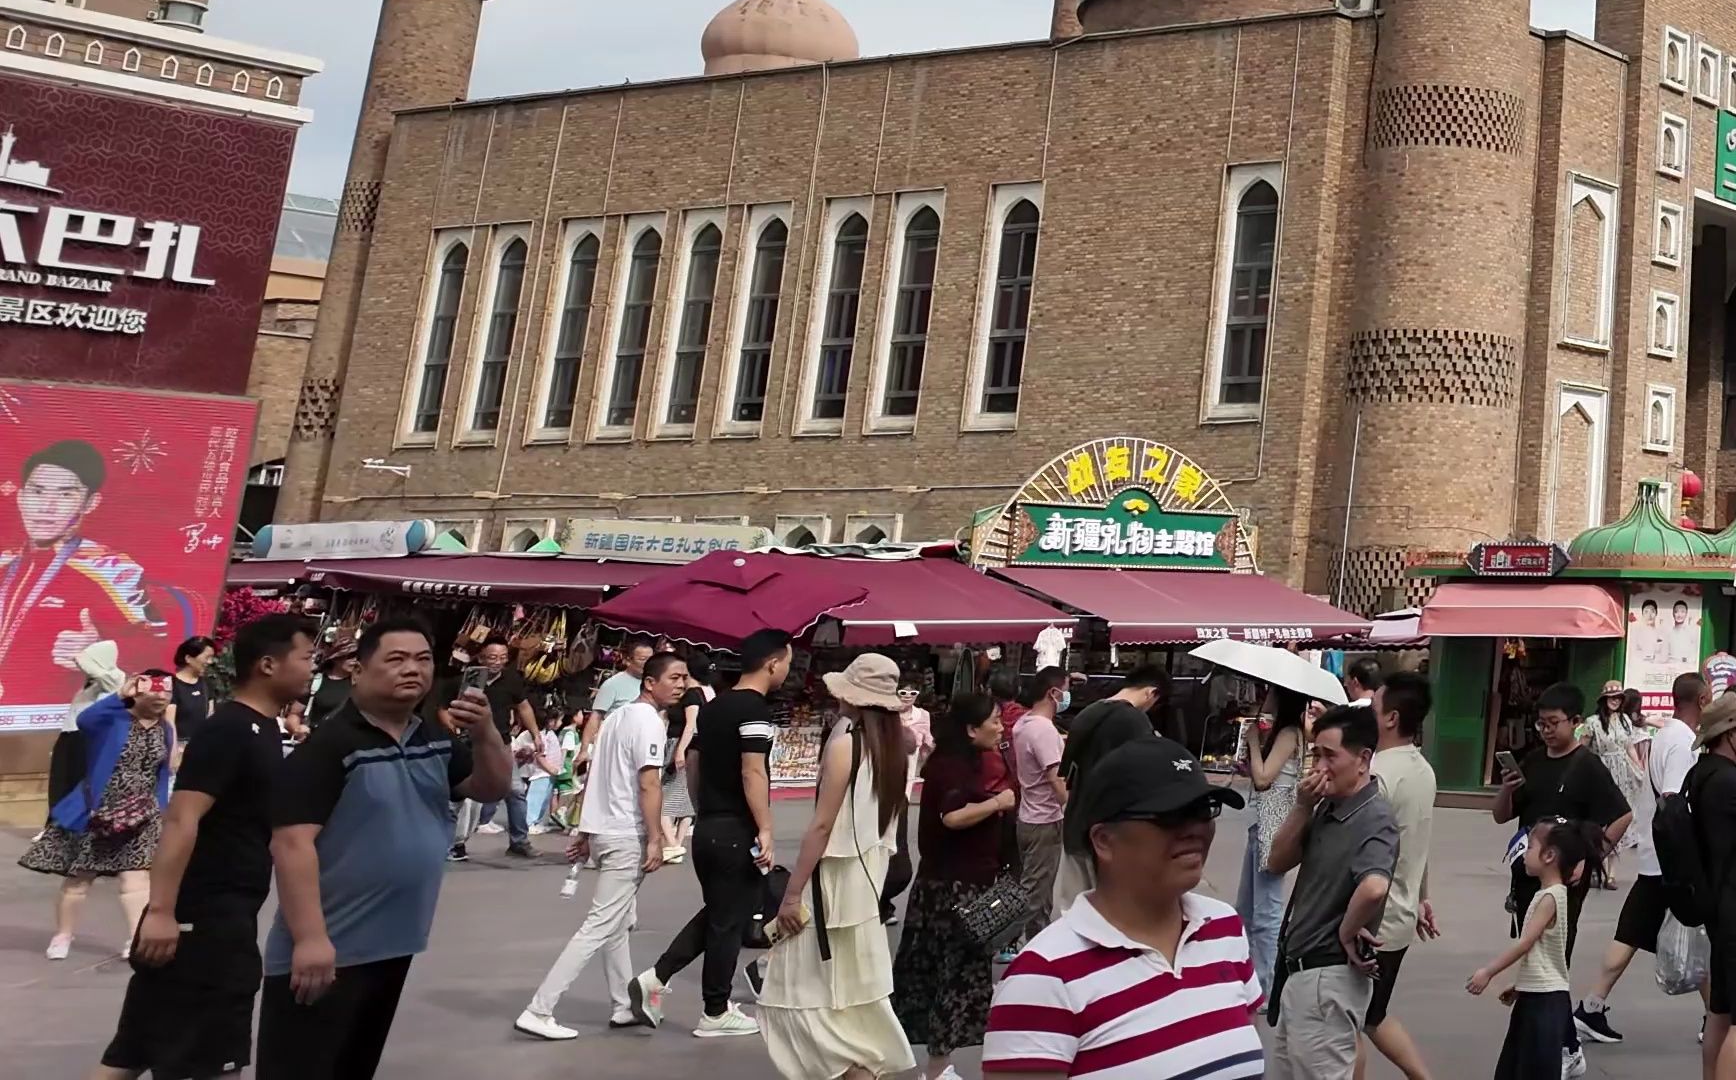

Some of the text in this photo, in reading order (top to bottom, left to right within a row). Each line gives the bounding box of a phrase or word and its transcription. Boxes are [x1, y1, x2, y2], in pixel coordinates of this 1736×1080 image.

[45, 273, 113, 293] BAZAAR
[0, 295, 148, 334] 景区欢迎您
[1066, 445, 1203, 504] 战友之家
[585, 532, 740, 555] 新疆国际大巴扎文创店
[1039, 512, 1216, 557] 新疆礼物主题馆
